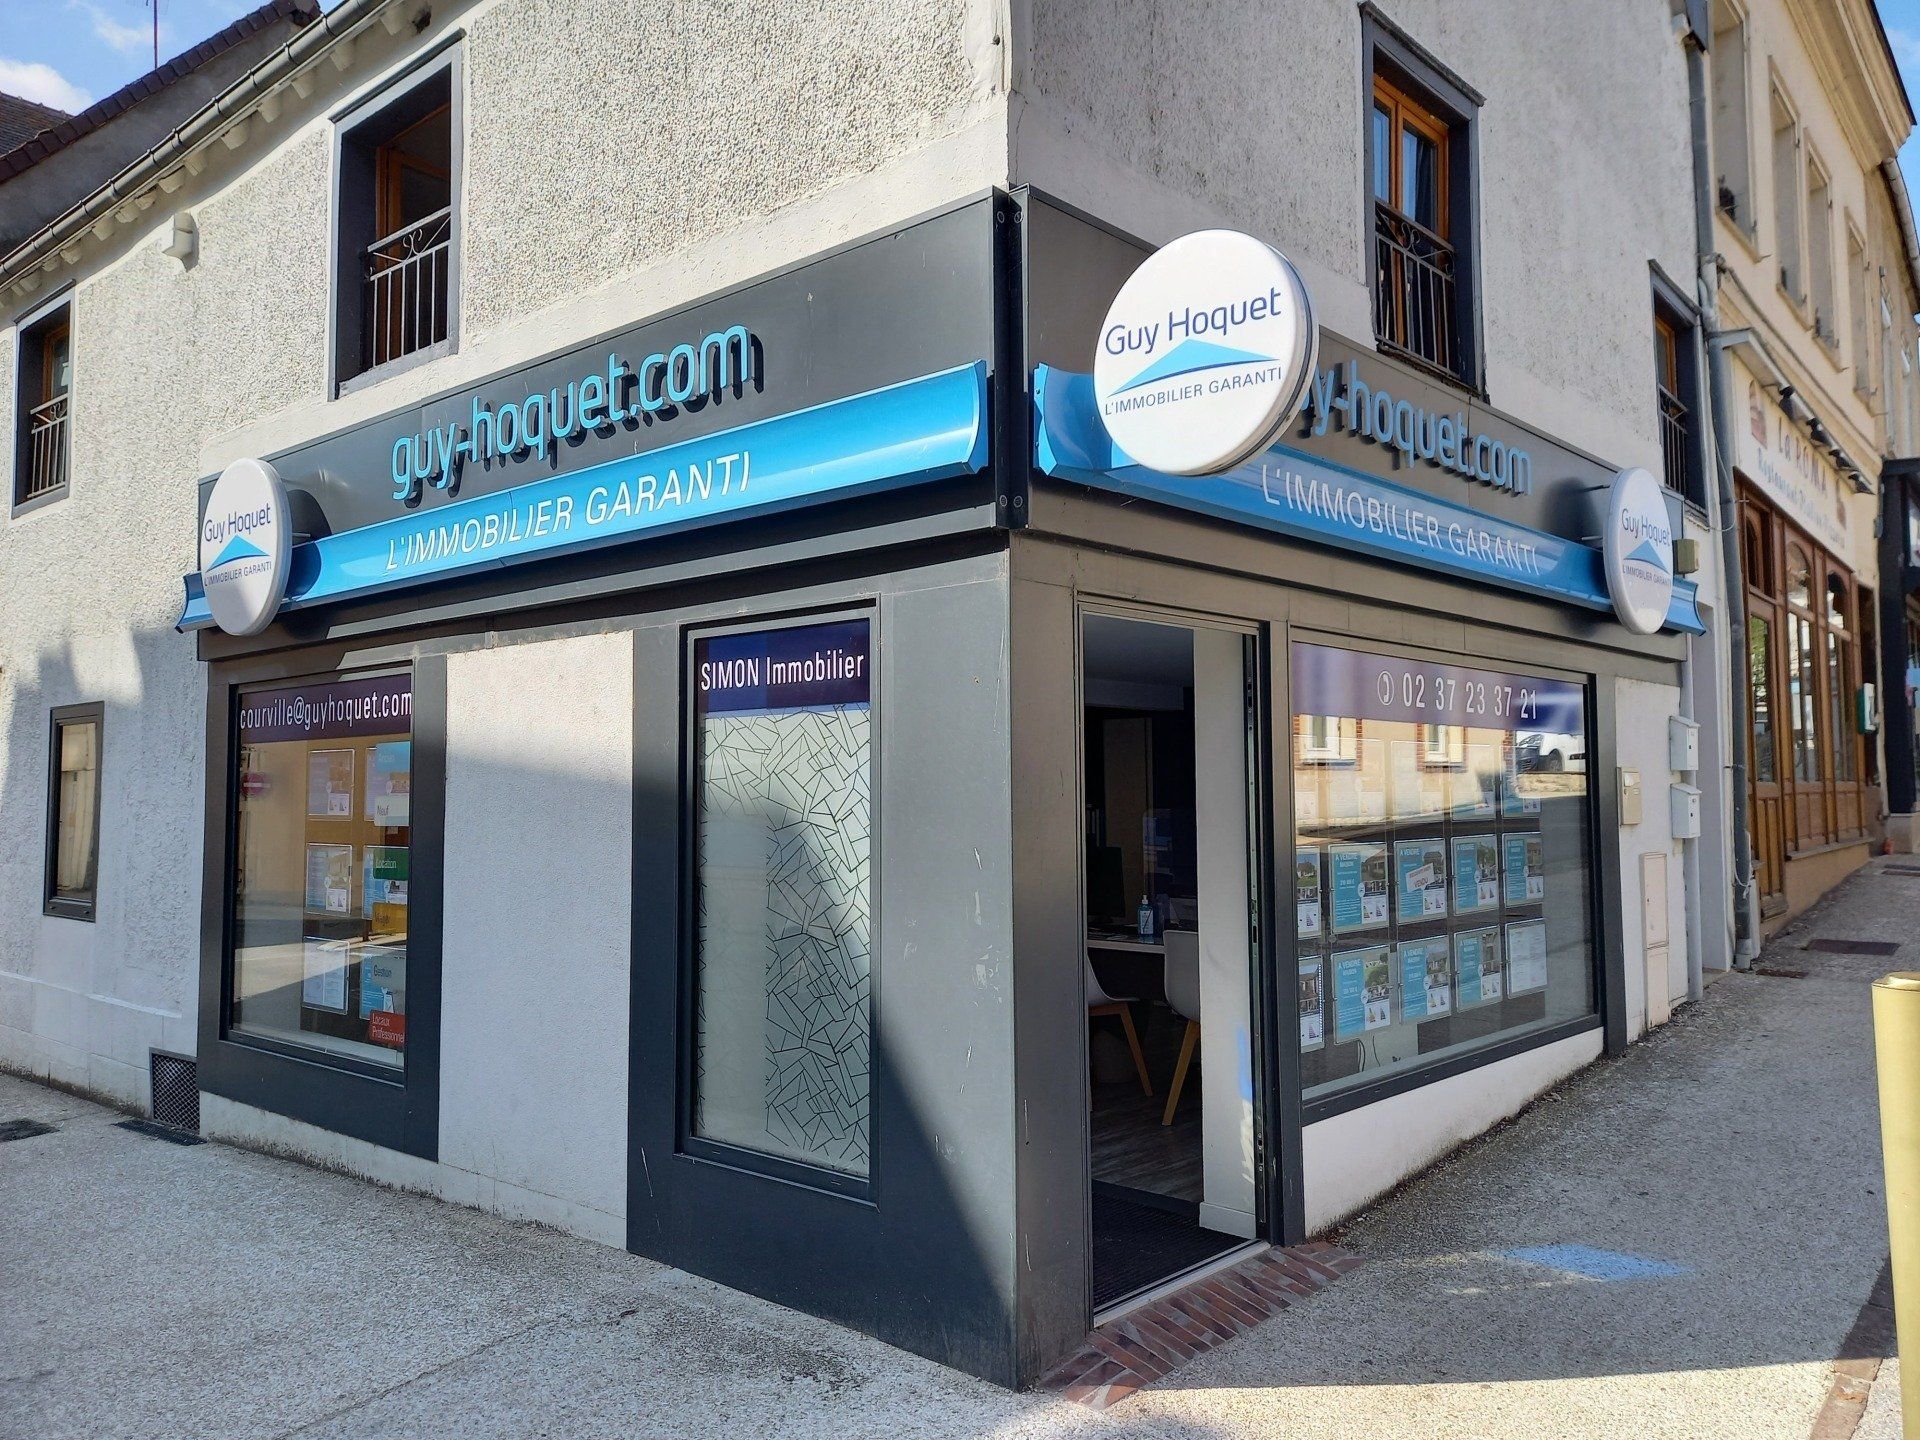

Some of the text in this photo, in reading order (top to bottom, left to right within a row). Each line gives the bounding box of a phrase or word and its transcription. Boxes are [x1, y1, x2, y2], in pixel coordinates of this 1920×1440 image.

[1105, 286, 1282, 357] Guy Hoquet
[391, 324, 751, 502] guy-hoquet.com
[1105, 366, 1282, 416] L'IMMOBILIER GARANTI
[204, 502, 271, 543] Guy Hoquet
[385, 451, 752, 570] L'IMMOBILIER GARANTI
[1262, 464, 1540, 576] L'IMMOBILIER GARANTI
[1622, 508, 1671, 547] Guy Hoquet
[204, 560, 272, 587] L'IMMOBILIER GARANTI
[701, 649, 866, 691] SIMON Immobilier
[240, 691, 412, 731] courville@guyhoquet.com
[1403, 672, 1537, 719] 02 37 23 37 21
